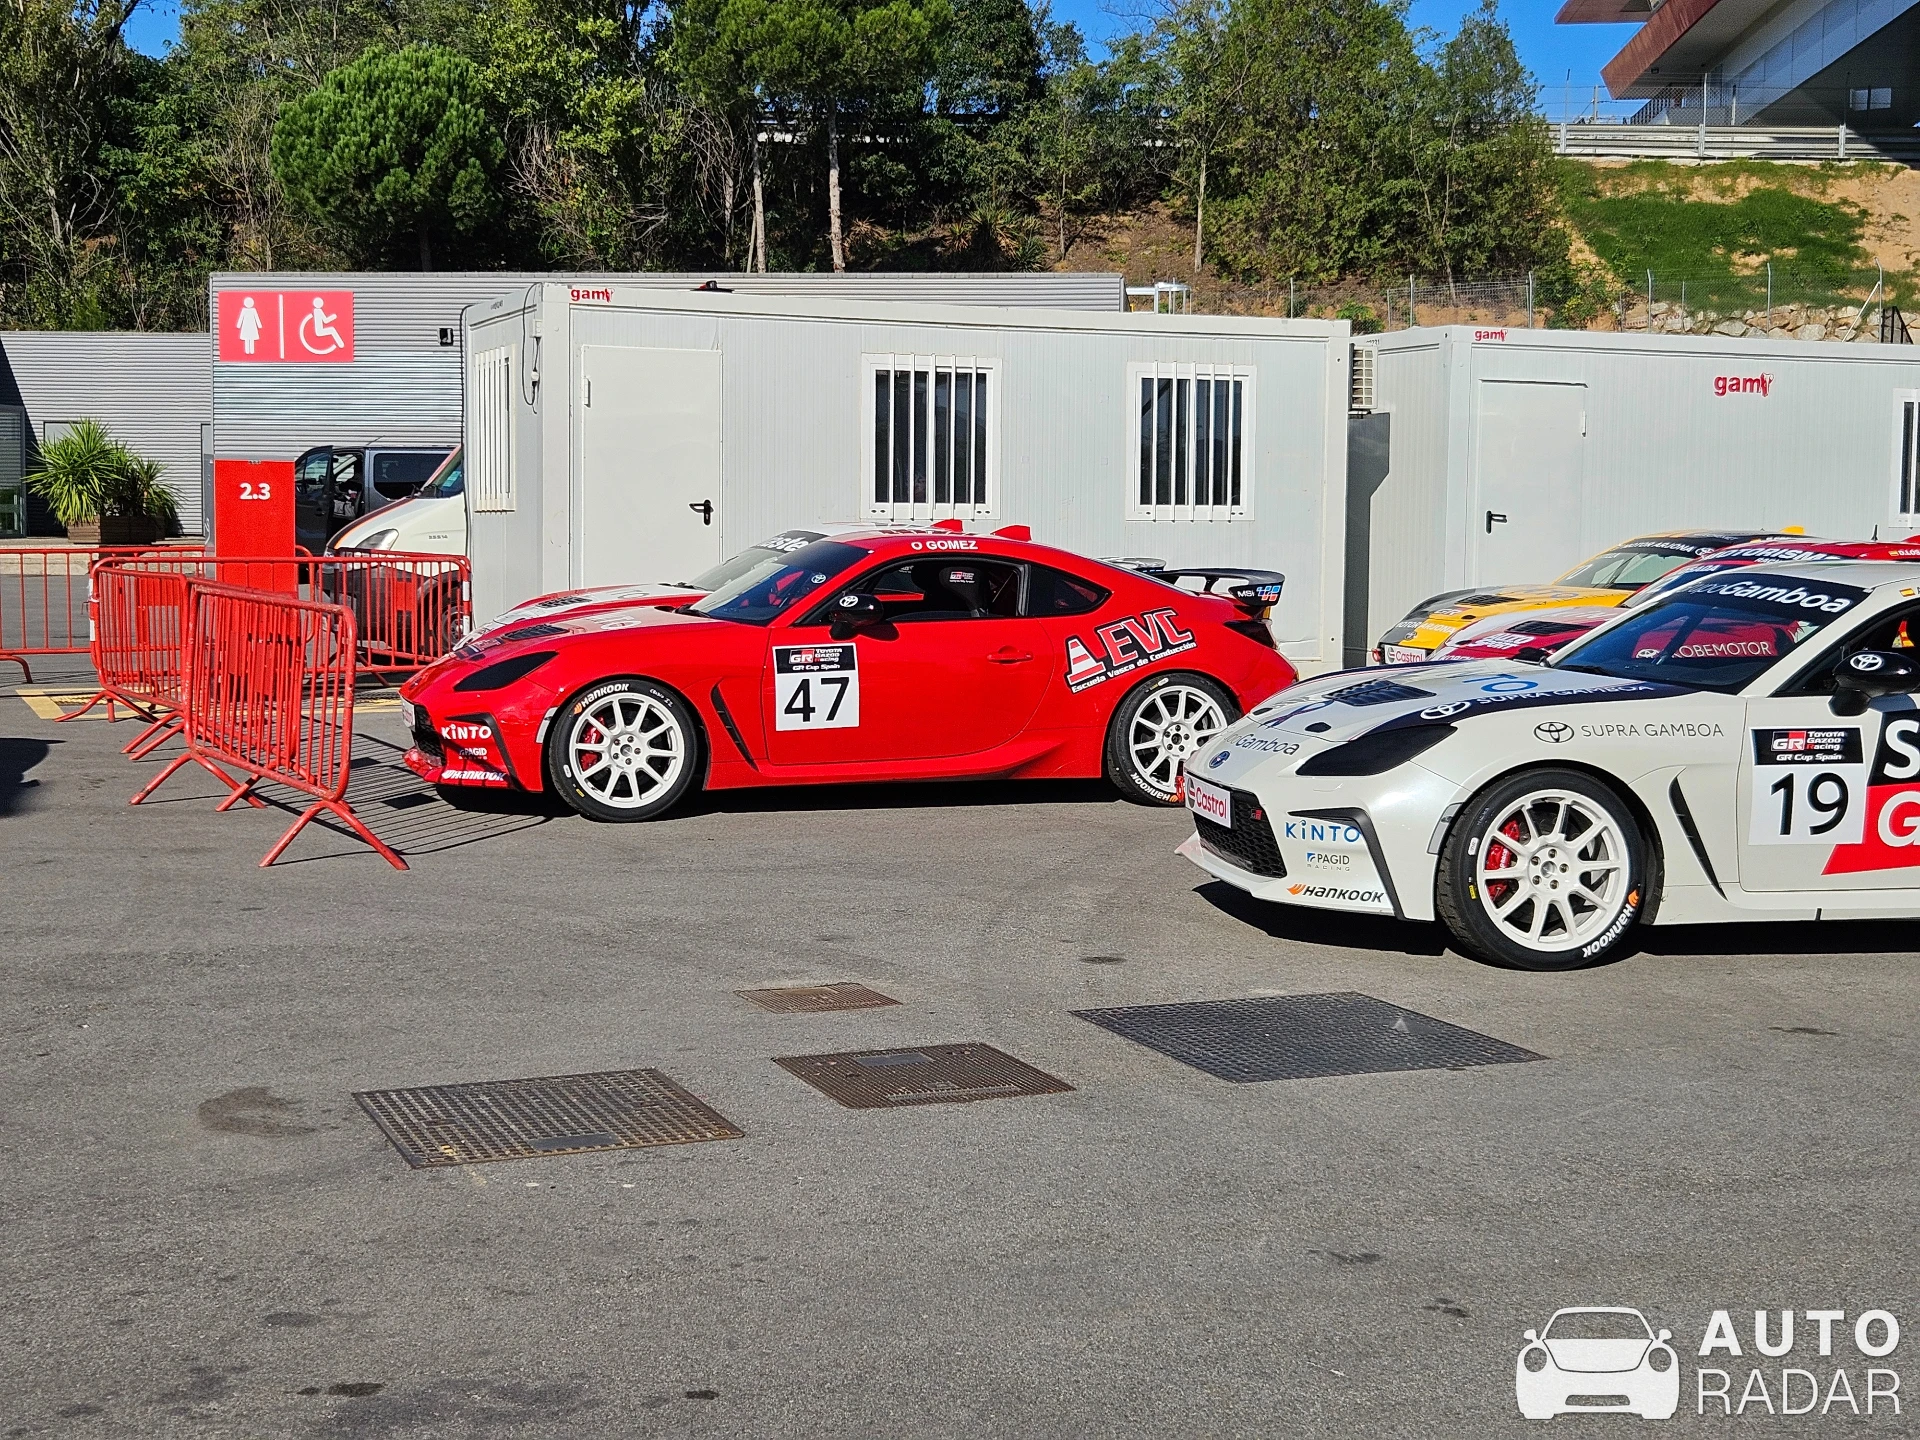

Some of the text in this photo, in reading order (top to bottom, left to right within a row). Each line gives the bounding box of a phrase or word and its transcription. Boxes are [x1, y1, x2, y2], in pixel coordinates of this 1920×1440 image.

[239, 482, 271, 500] 2.3
[926, 541, 978, 550] GOMEZ
[1672, 642, 1772, 658] OBEMOTOR
[1072, 642, 1196, 693] Escuela Vasca de Conducción
[784, 676, 850, 722] 47
[1581, 723, 1724, 737] SUPRA GAMBOA
[1773, 738, 1804, 750] GR
[1806, 743, 1840, 751] Racing
[1794, 754, 1813, 762] Cup
[1815, 753, 1842, 762] Spain
[1195, 787, 1227, 819] Castrol
[1771, 772, 1849, 836] 19
[1317, 853, 1350, 865] PAGID
[1307, 864, 1350, 872] RACING
